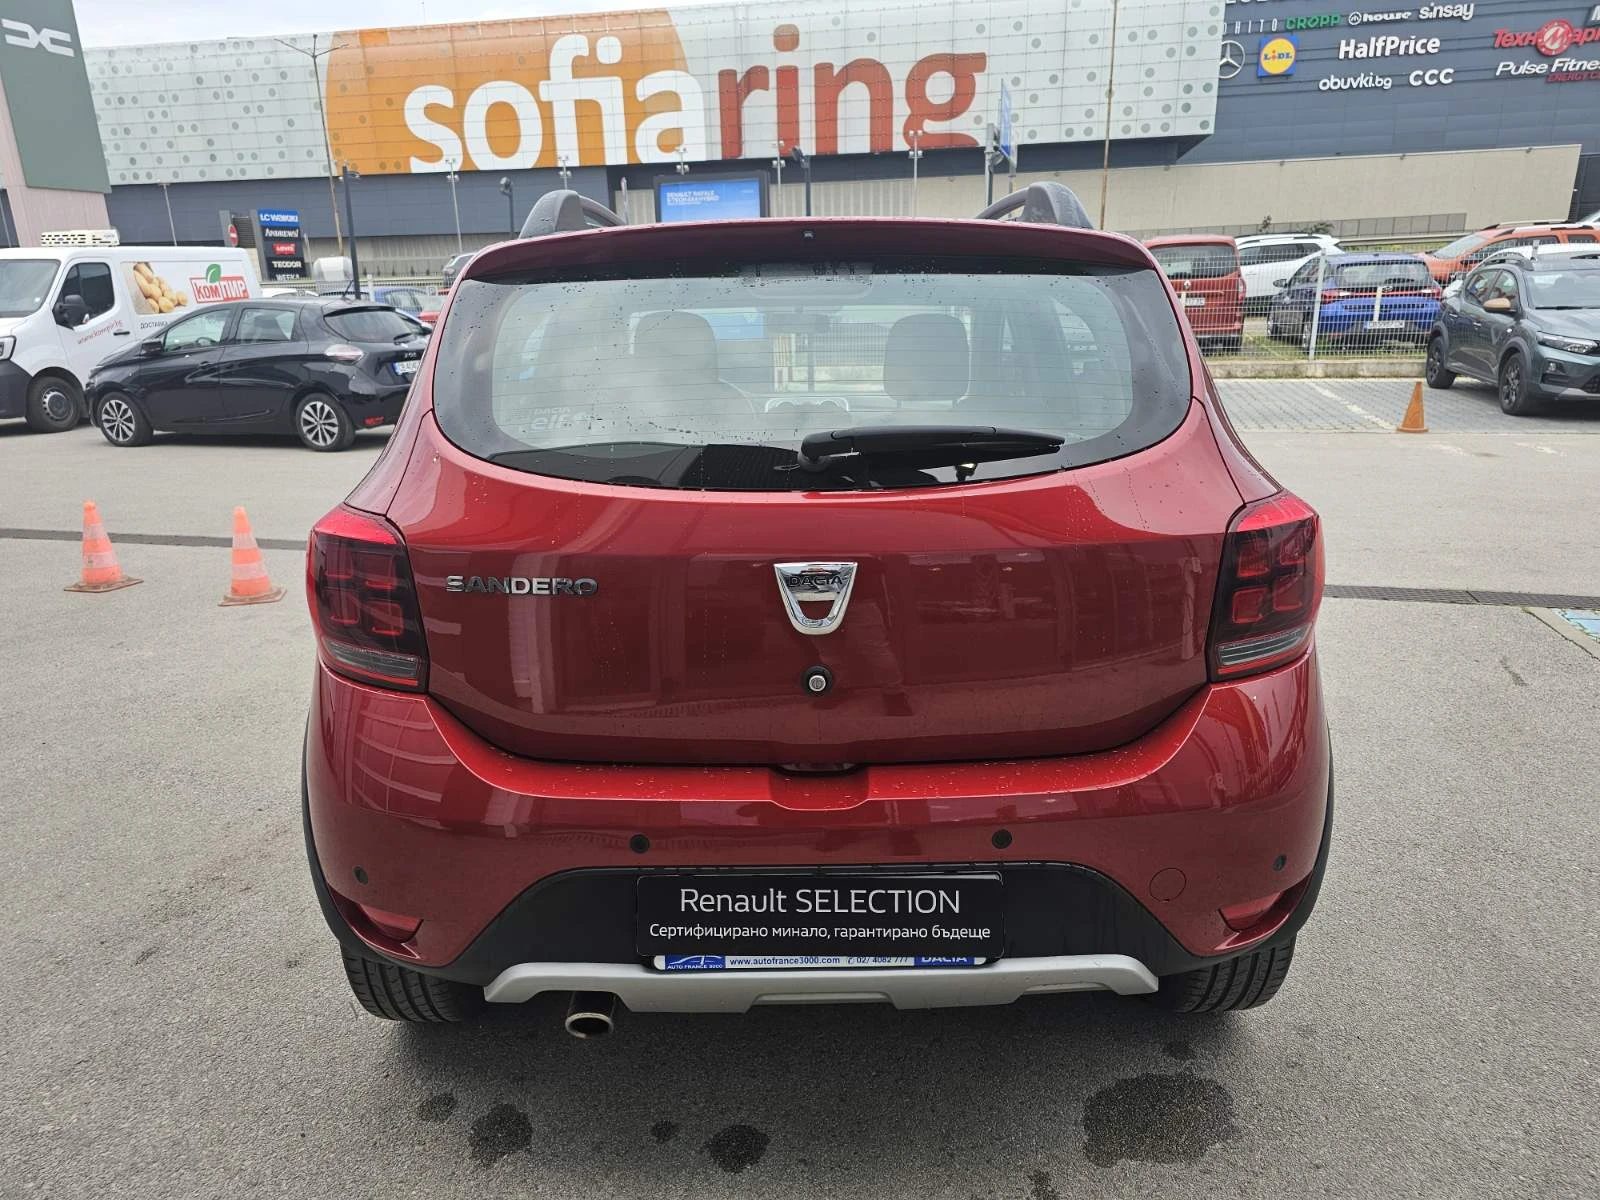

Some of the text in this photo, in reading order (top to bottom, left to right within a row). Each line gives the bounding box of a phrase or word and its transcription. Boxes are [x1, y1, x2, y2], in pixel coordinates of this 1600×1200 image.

[1419, 2, 1475, 21] sinsay
[1286, 14, 1341, 30] CROPP
[1338, 35, 1441, 60] HalfPrice
[1495, 57, 1600, 76] Pulse Fitne
[1318, 72, 1392, 91] obuvki.bg
[1409, 68, 1454, 87] CCC
[446, 575, 598, 595] SANDERO
[788, 575, 843, 587] DACIA
[680, 888, 960, 914] Renault SELECTION
[649, 923, 991, 941] Сертифицирано минало, гарантирано бъдеще
[730, 956, 840, 966] www.autofrance3000.com
